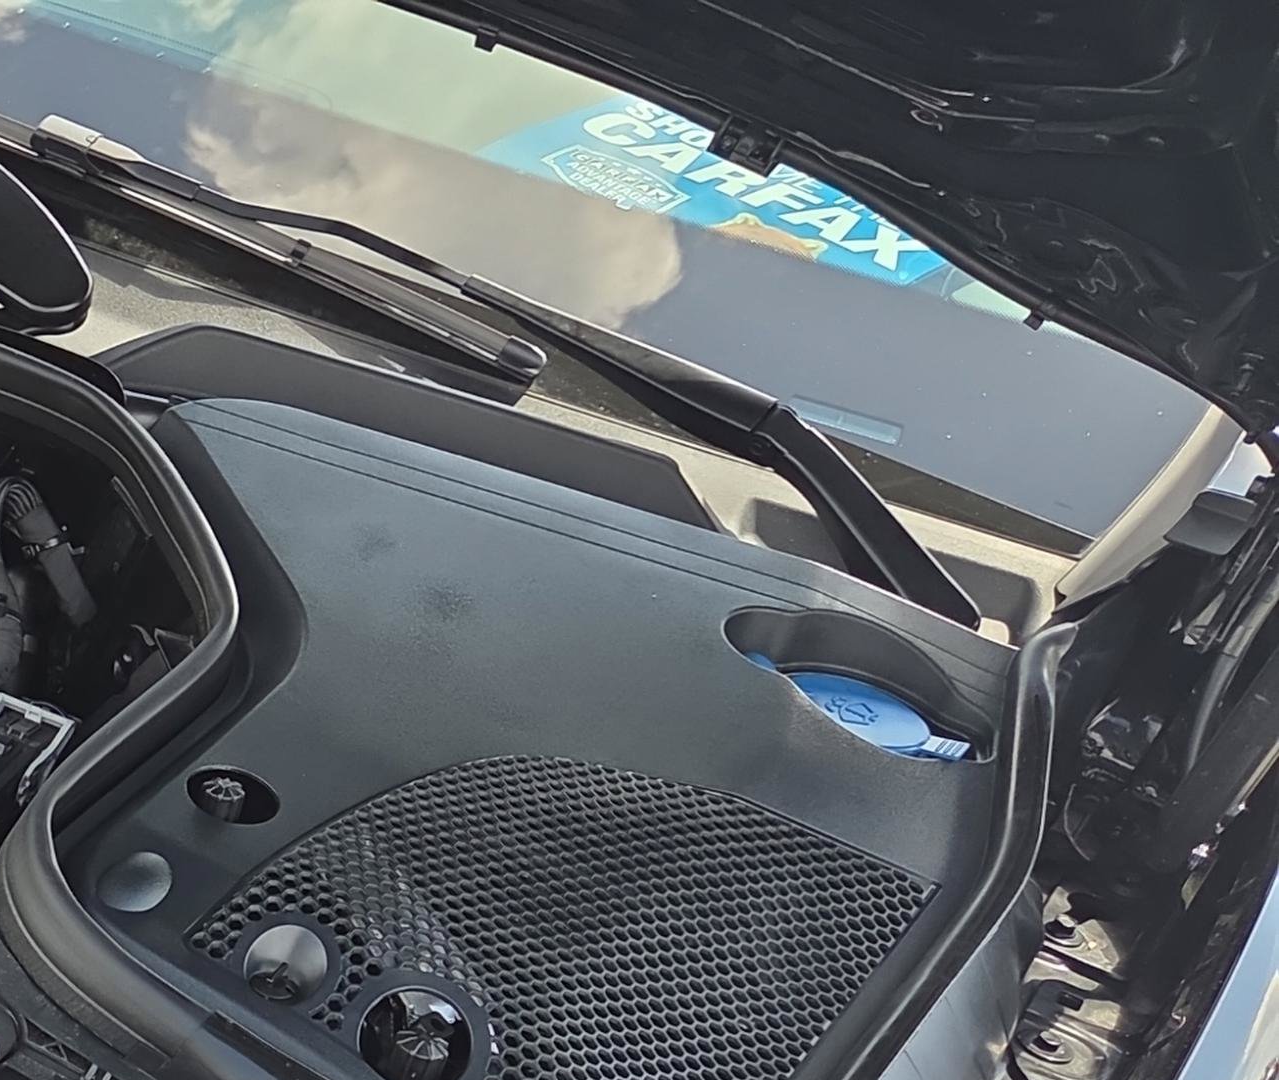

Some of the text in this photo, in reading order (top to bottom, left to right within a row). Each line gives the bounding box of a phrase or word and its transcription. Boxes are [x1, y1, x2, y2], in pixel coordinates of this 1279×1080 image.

[626, 101, 714, 147] SHO
[567, 160, 651, 206] ADVANTAGE
[568, 148, 673, 205] CARFAX
[569, 171, 625, 206] DEALER
[582, 112, 931, 272] CARFAX
